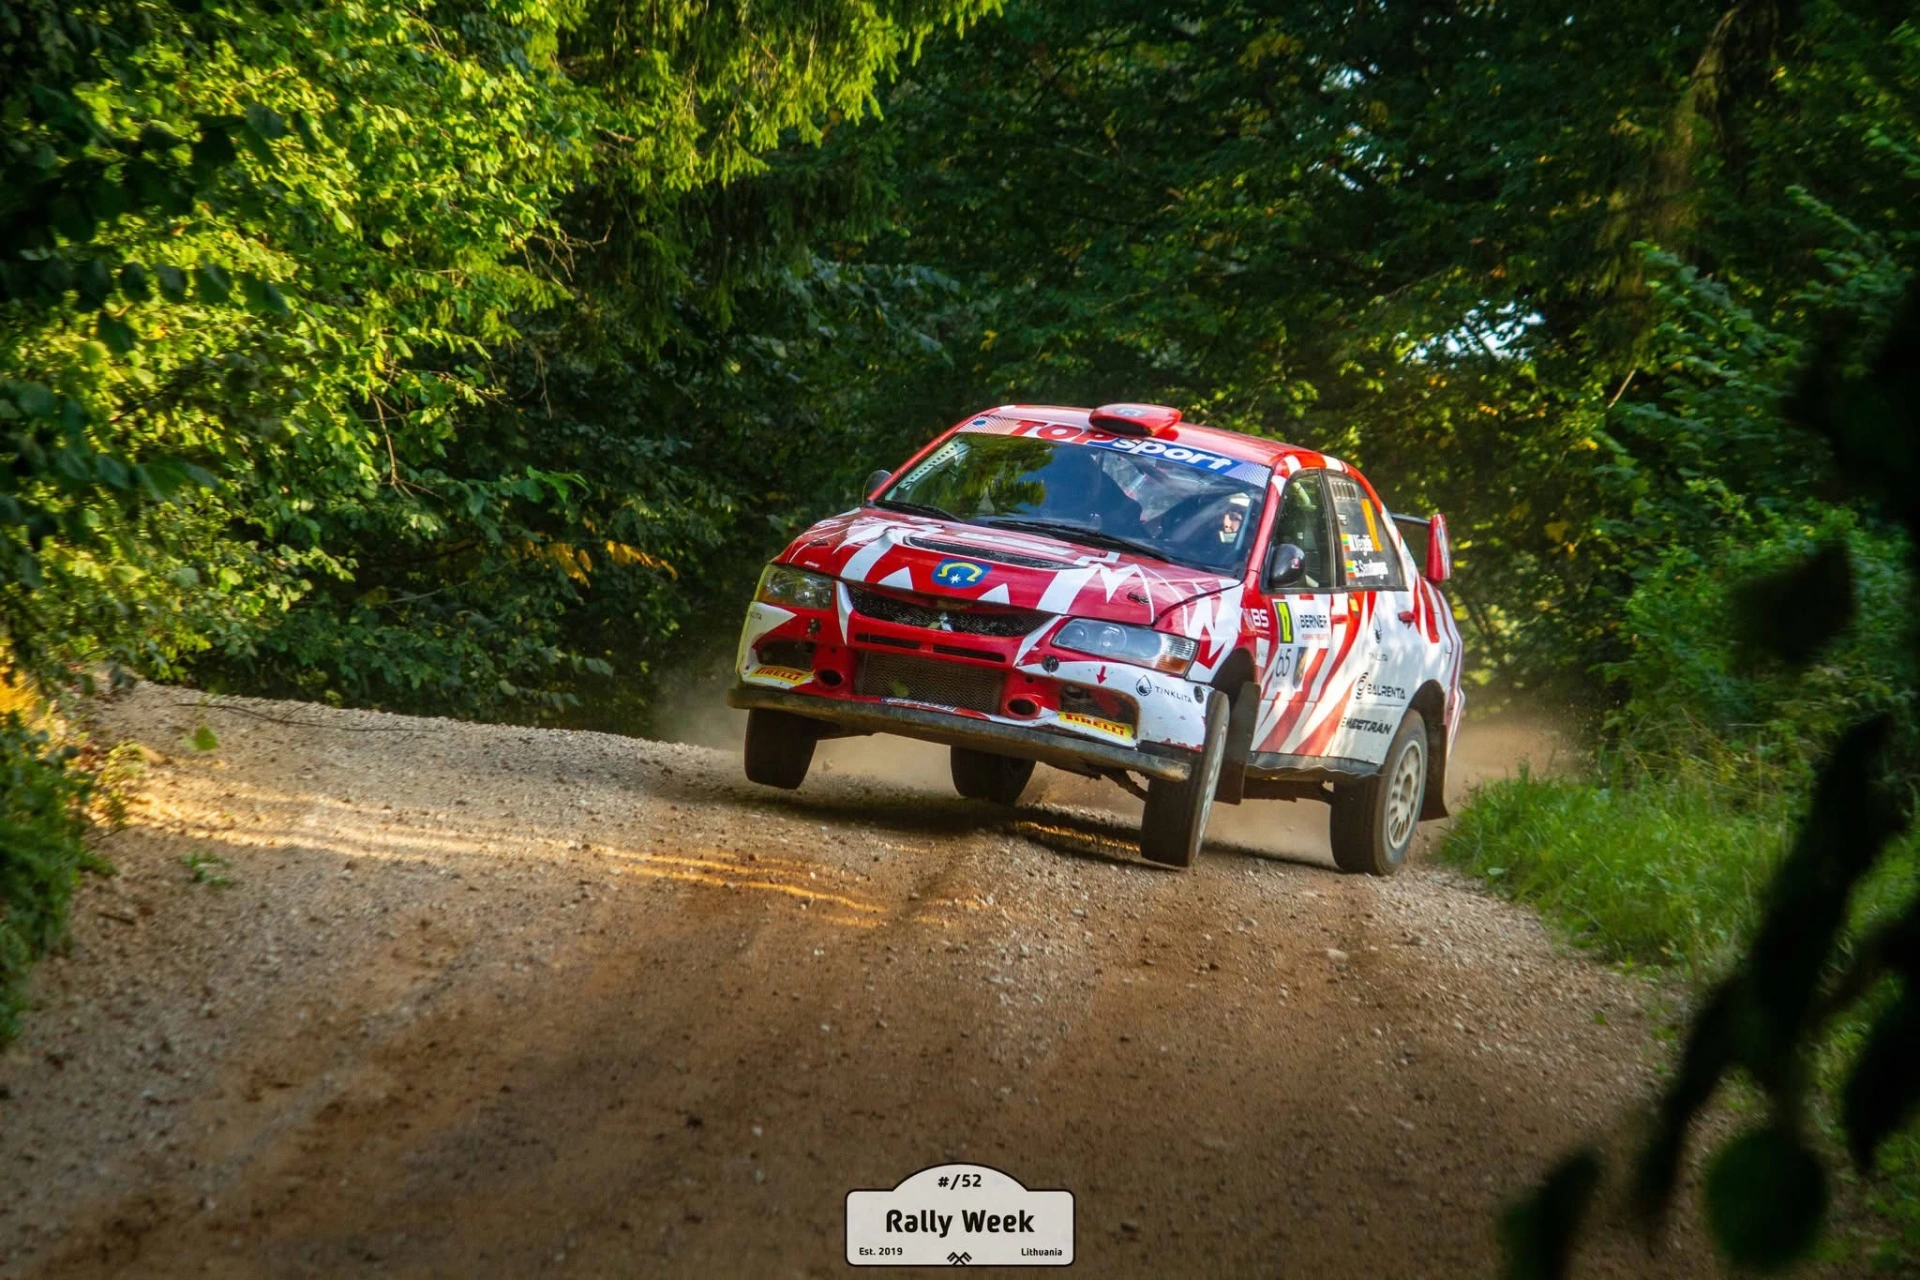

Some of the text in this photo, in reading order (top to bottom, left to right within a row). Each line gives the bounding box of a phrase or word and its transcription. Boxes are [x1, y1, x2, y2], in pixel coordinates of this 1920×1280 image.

[1299, 614, 1328, 629] BERNER
[755, 666, 804, 681] PIRELLI
[1155, 685, 1193, 703] TINKLITA
[1065, 713, 1125, 736] PIRELLI
